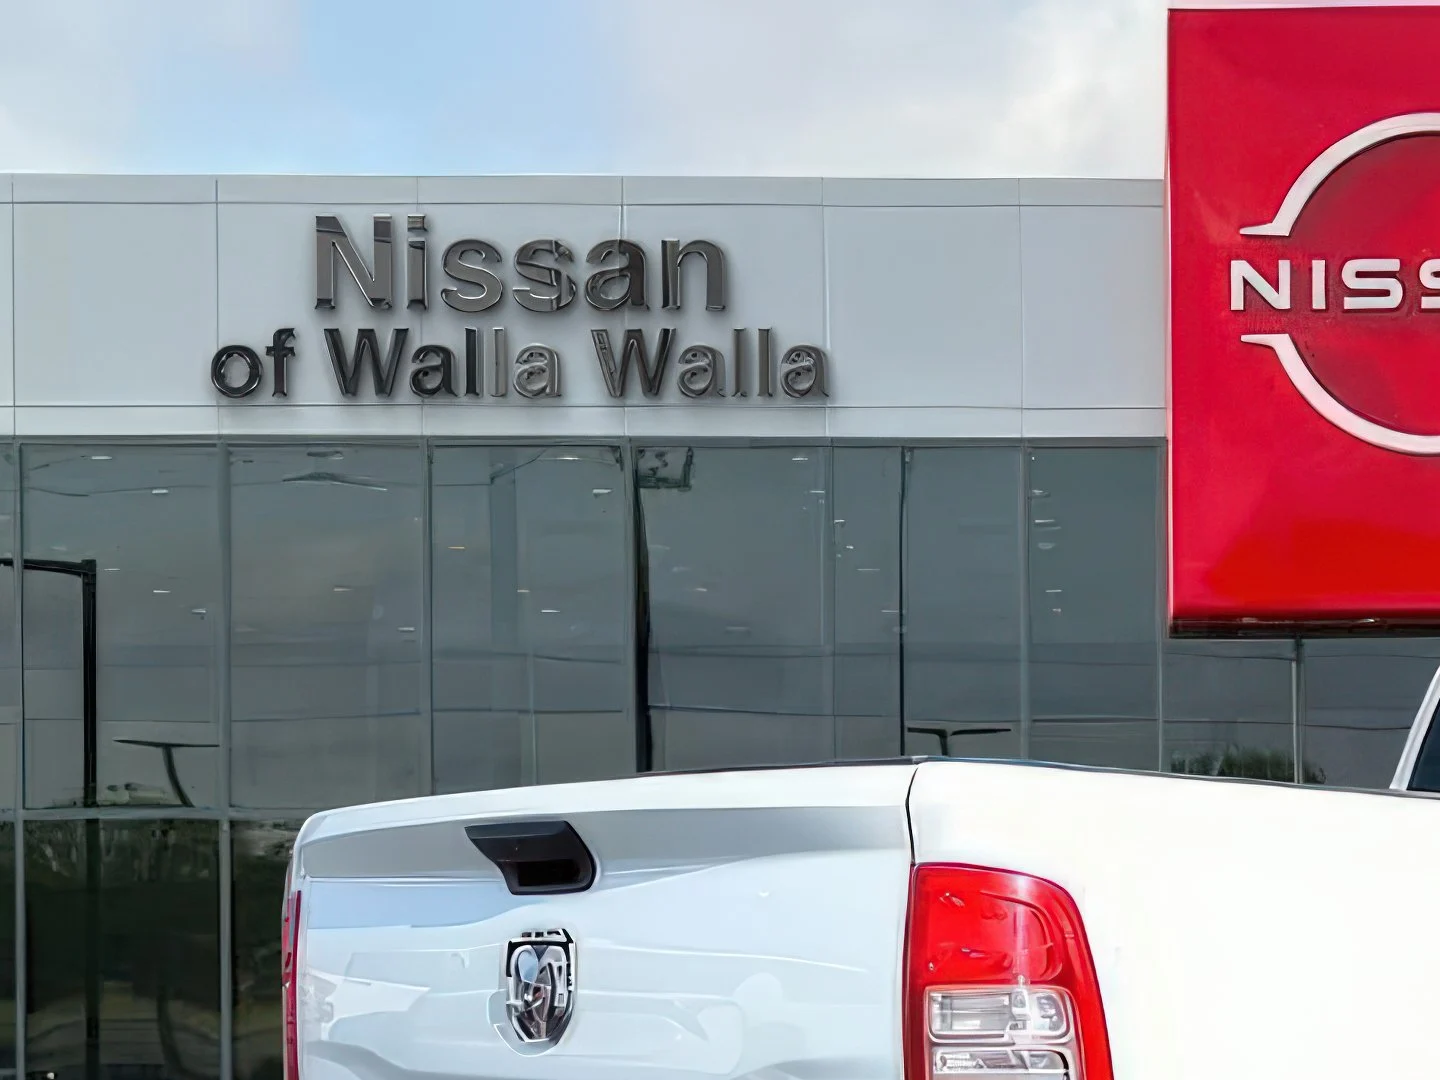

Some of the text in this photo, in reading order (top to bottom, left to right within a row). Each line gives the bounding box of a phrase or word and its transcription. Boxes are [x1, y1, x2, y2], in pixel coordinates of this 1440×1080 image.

[313, 212, 728, 312] Nissan
[210, 326, 830, 398] of Walla Walla
